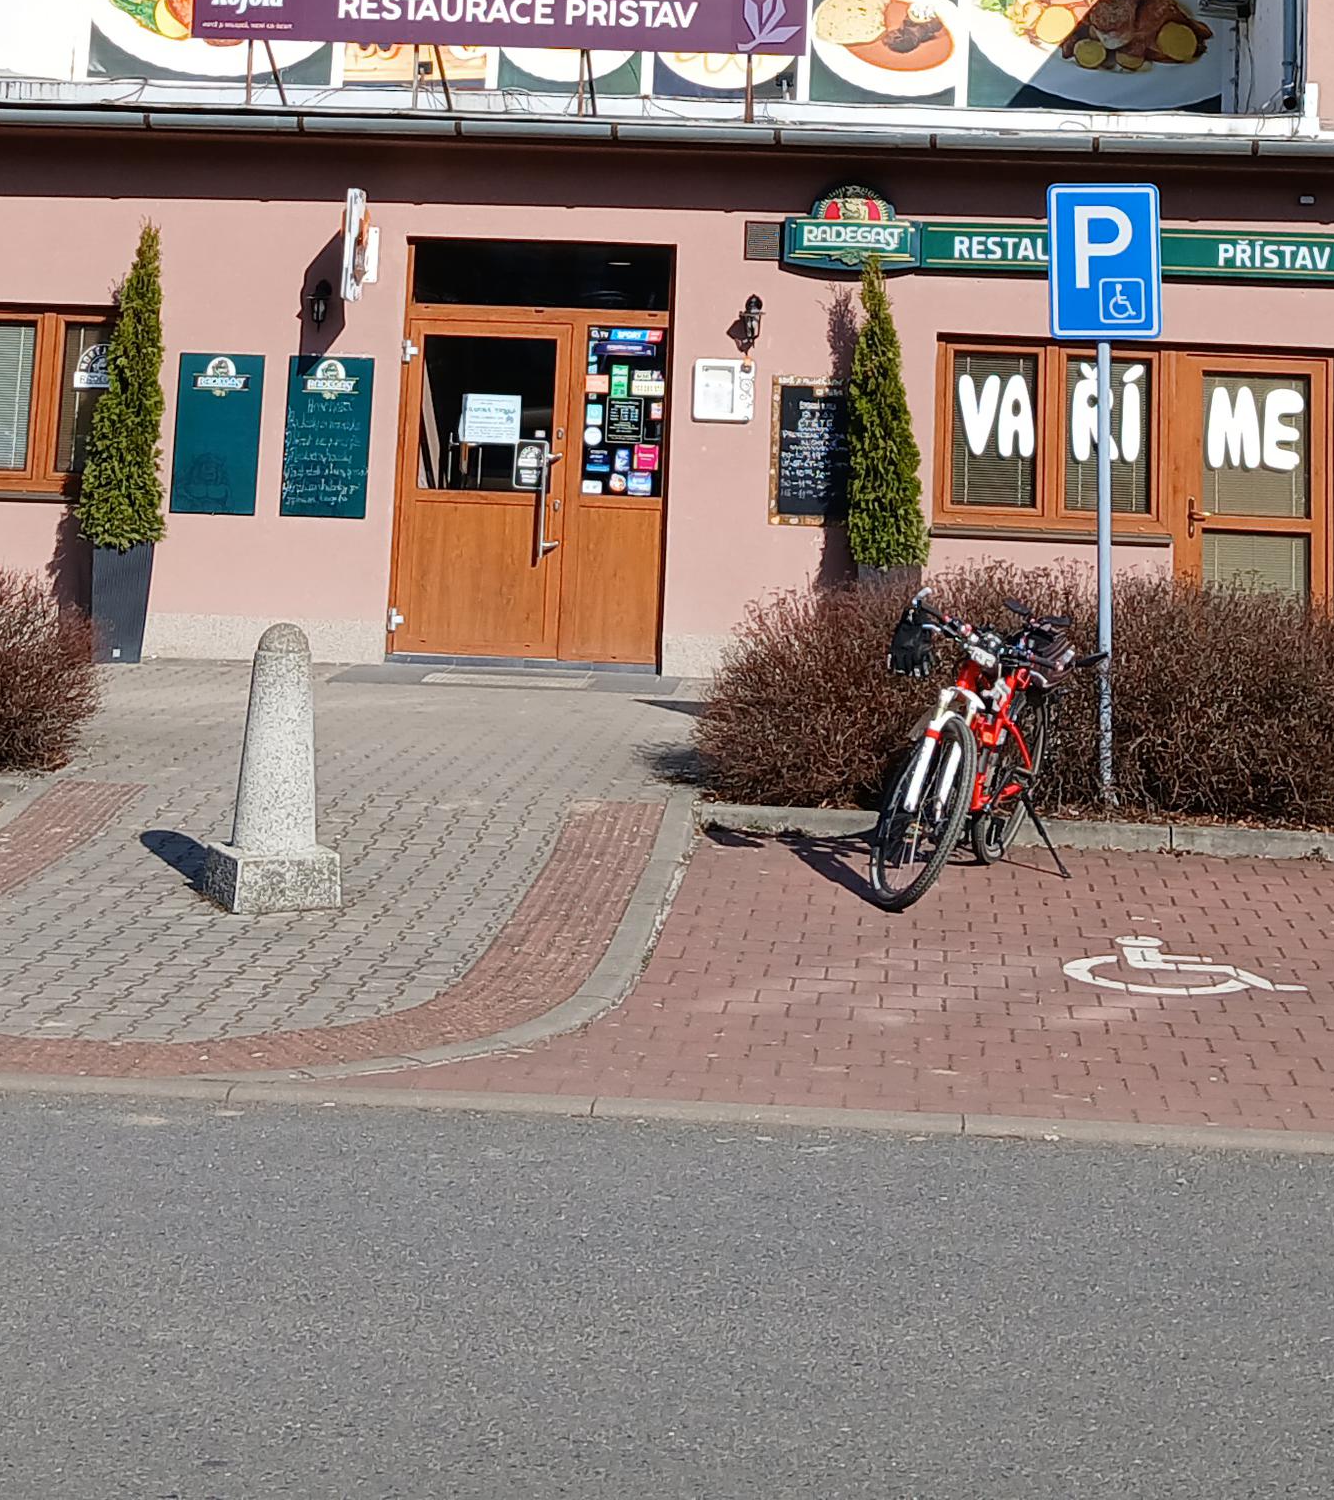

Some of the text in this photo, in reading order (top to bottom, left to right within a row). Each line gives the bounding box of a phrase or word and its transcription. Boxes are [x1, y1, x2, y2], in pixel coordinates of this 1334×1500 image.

[803, 225, 900, 250] RADEGAST
[954, 236, 1331, 269] RESTAU PŘÍSTAV
[1074, 205, 1133, 289] P
